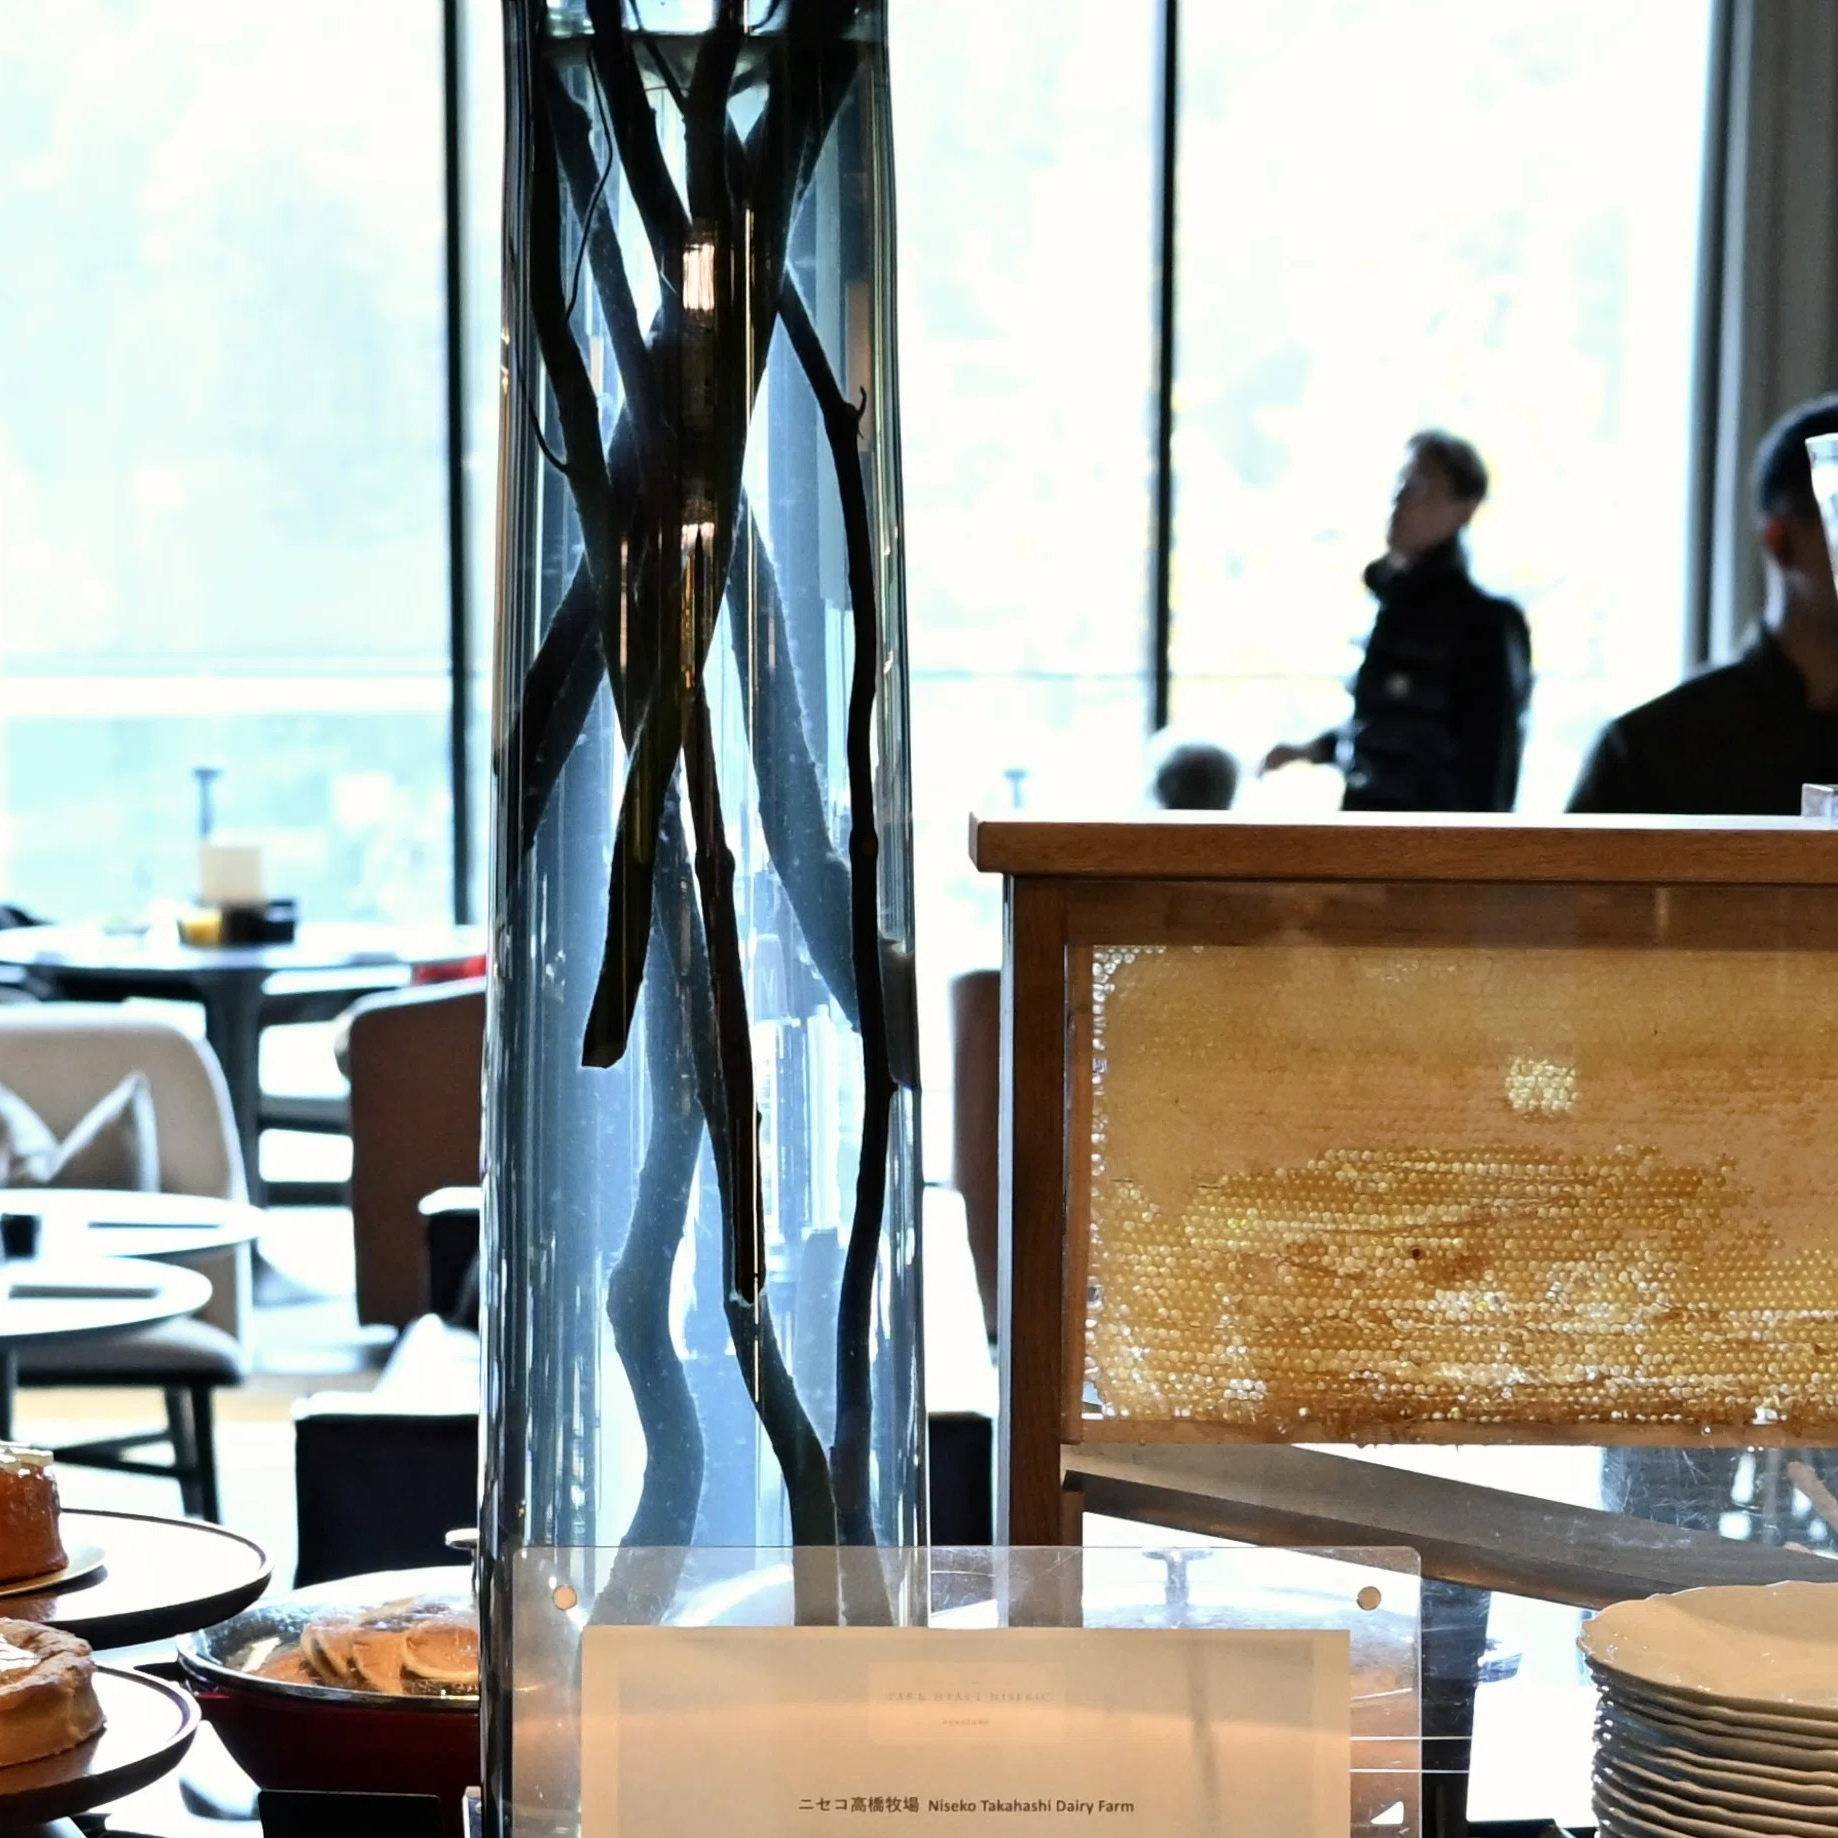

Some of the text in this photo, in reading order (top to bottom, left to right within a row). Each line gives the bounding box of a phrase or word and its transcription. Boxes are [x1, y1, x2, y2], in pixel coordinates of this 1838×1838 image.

[928, 1799, 1135, 1816] Niseko Takahashi Dairy Farm
